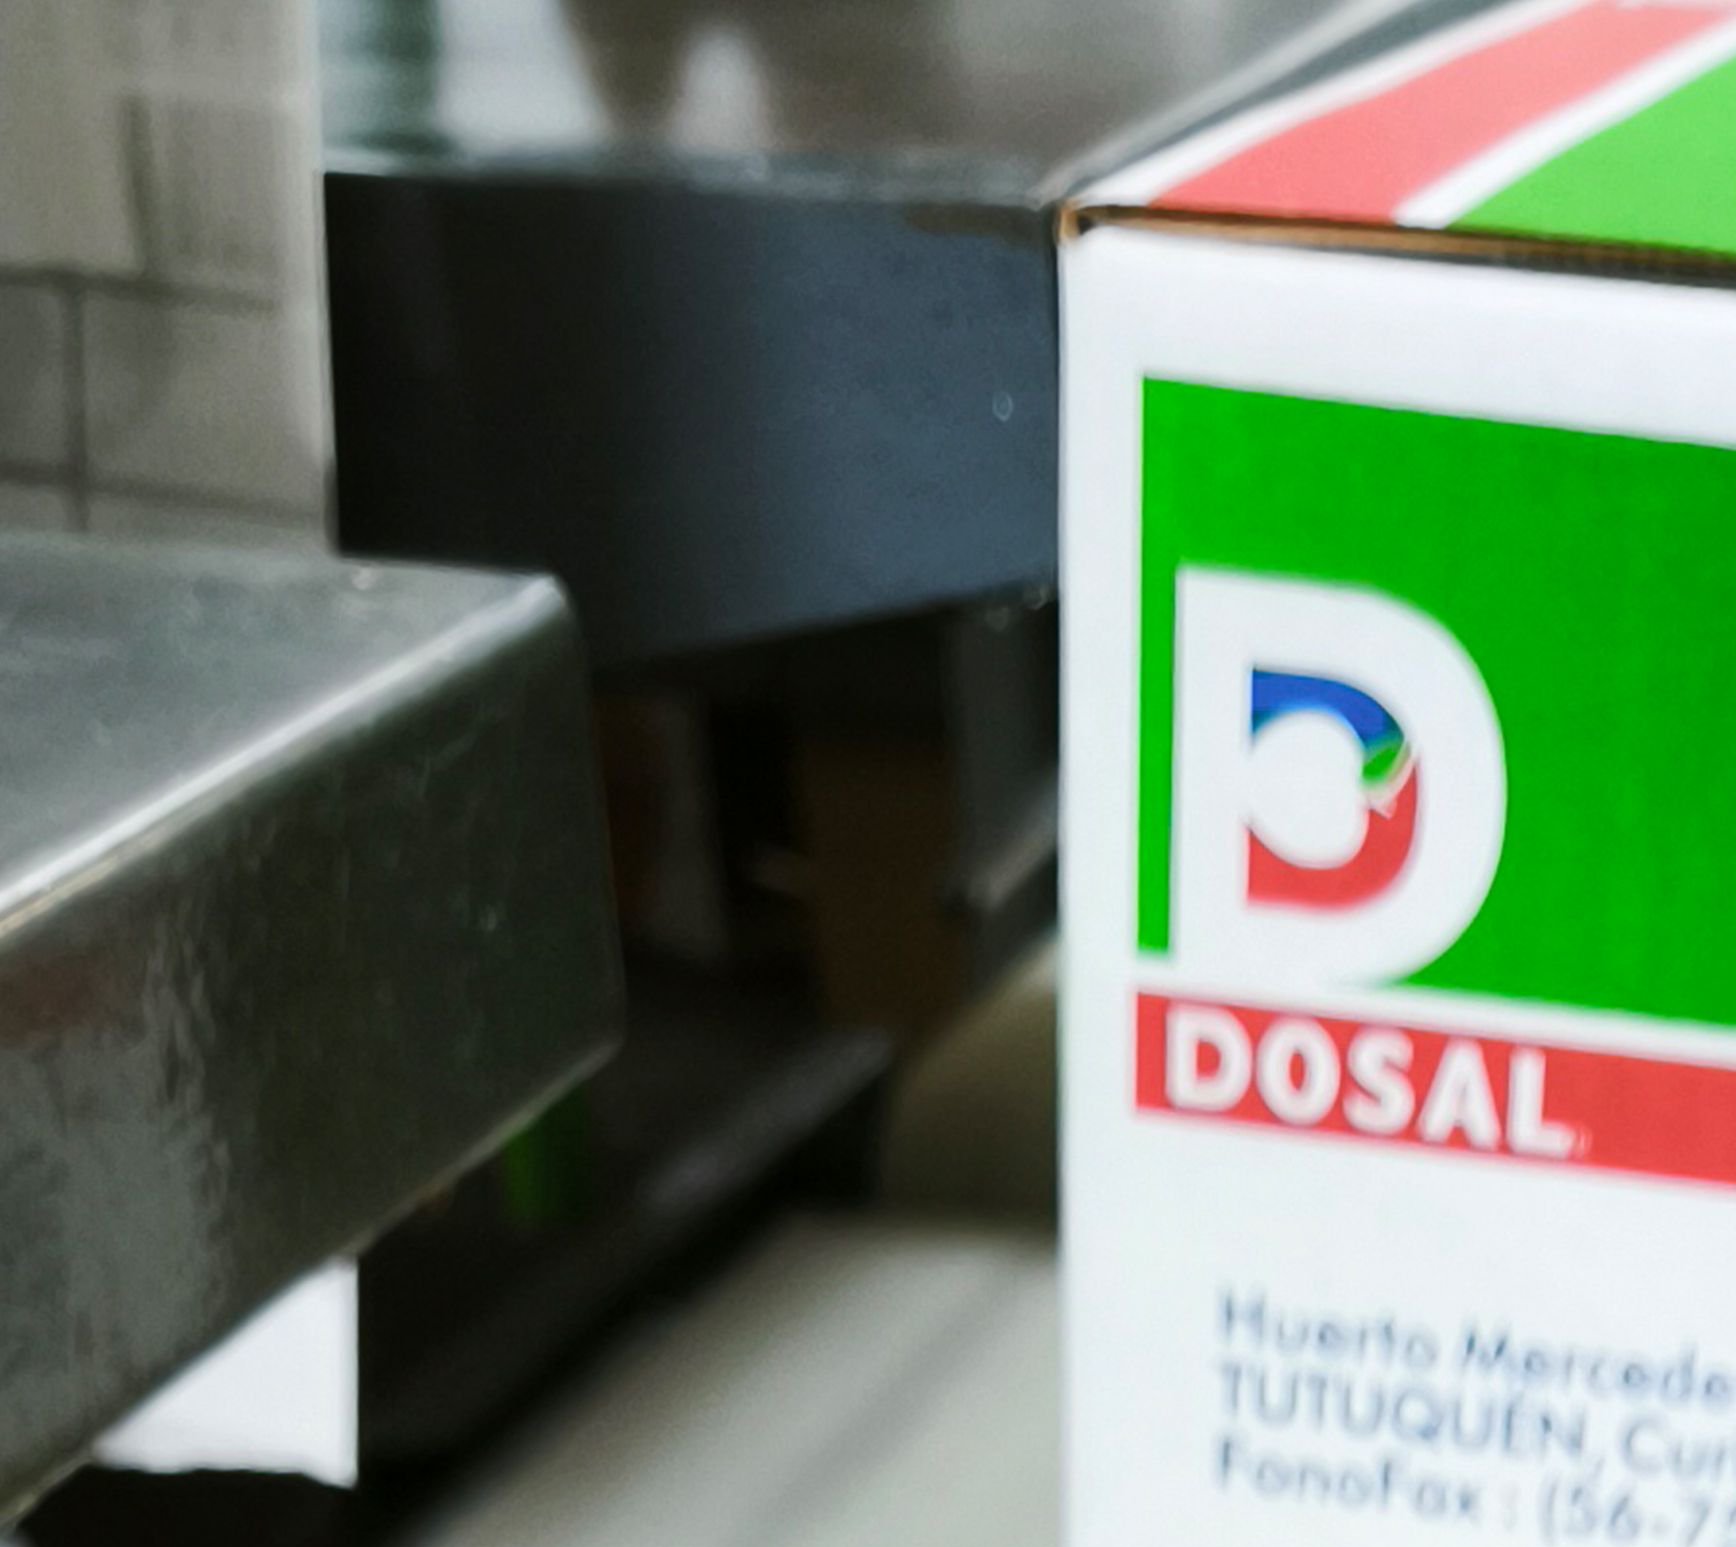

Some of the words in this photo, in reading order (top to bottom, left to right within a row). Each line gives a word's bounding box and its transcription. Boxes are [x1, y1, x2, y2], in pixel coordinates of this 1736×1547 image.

[1165, 1000, 1578, 1160] DOSAL
[1219, 1286, 1440, 1371] Huerto
[1217, 1430, 1481, 1523] FonoFax
